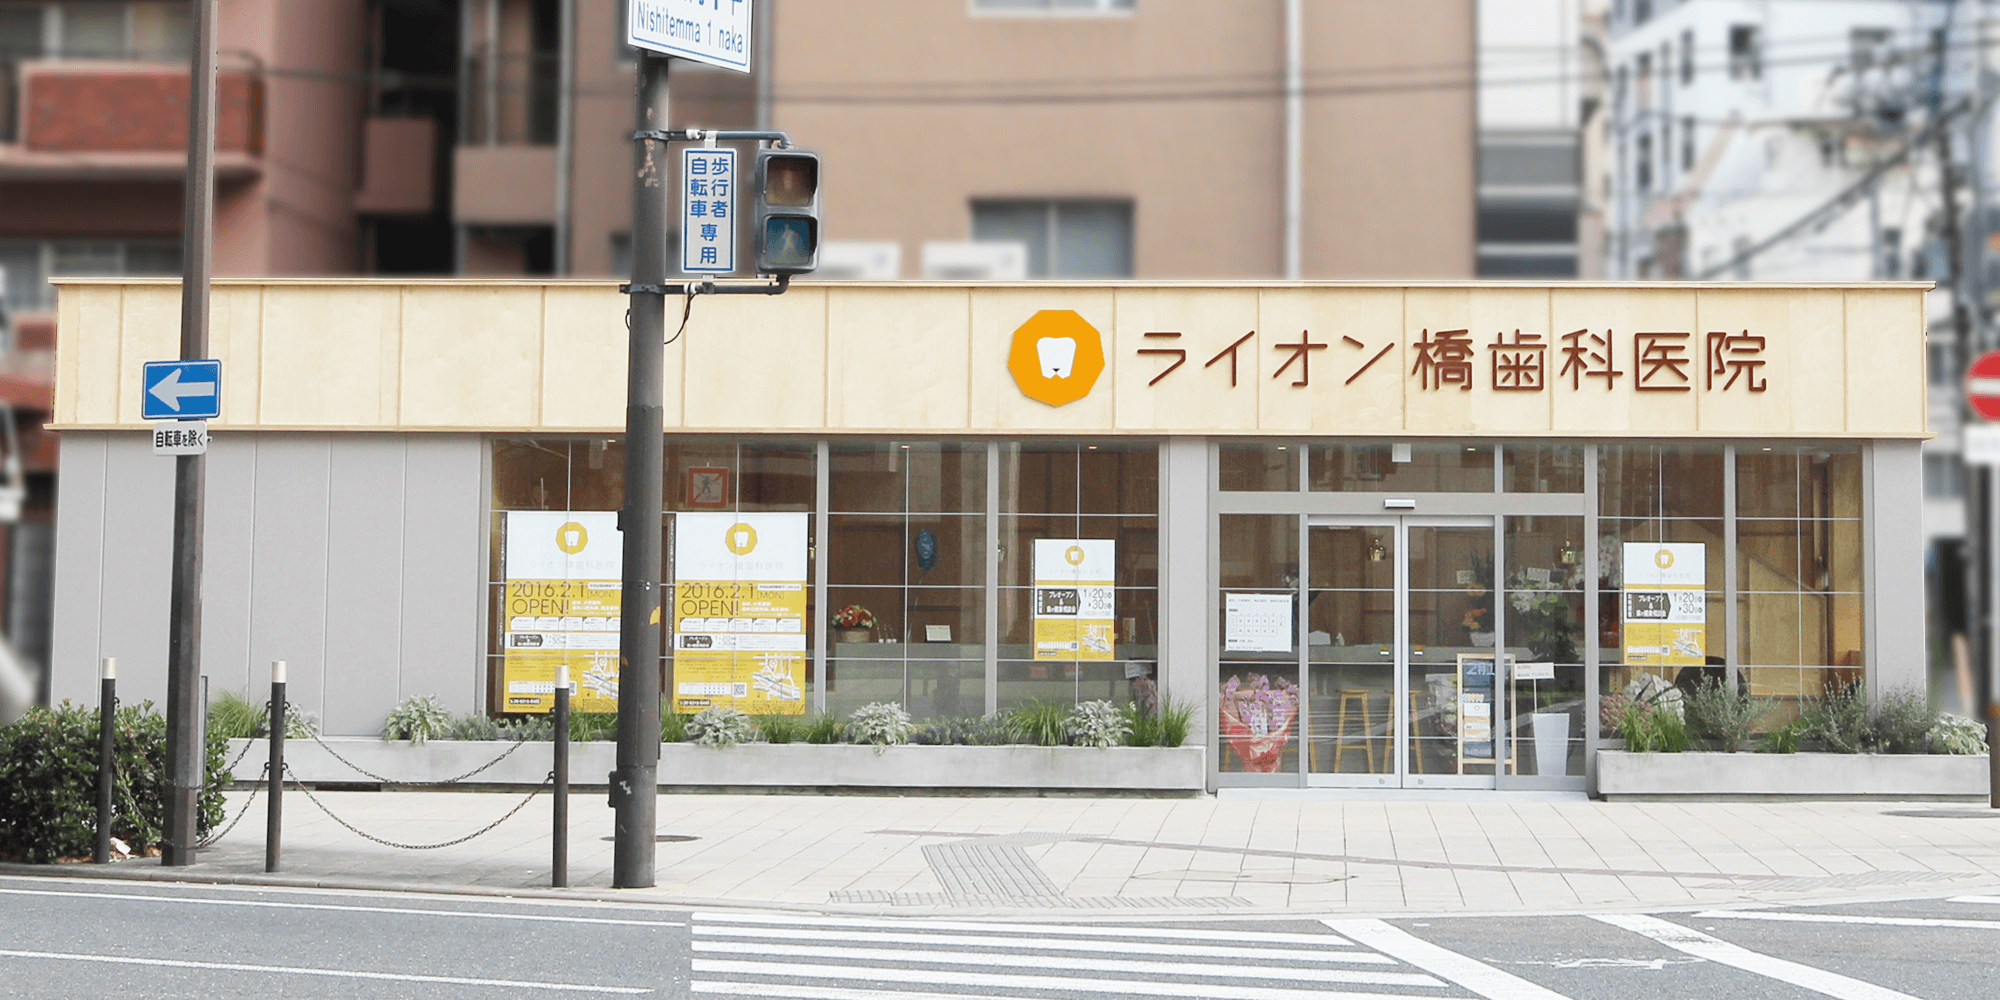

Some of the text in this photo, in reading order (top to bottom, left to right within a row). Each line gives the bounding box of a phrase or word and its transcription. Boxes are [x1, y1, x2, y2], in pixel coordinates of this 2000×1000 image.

[637, 1, 700, 43] Nishitemma
[707, 19, 712, 46] 1
[719, 25, 743, 53] naka
[690, 157, 708, 218] 自転車
[711, 157, 729, 218] 歩行者
[700, 223, 718, 265] 専用
[1137, 327, 1767, 393] ライオン橋歯科医院
[155, 429, 204, 448] 自転車を除く
[512, 581, 584, 598] 2016.2.1
[681, 582, 754, 599] 2016.2.1
[1048, 591, 1075, 599] プレオープン
[512, 598, 569, 615] OPEN!
[681, 599, 739, 616] OPEN!
